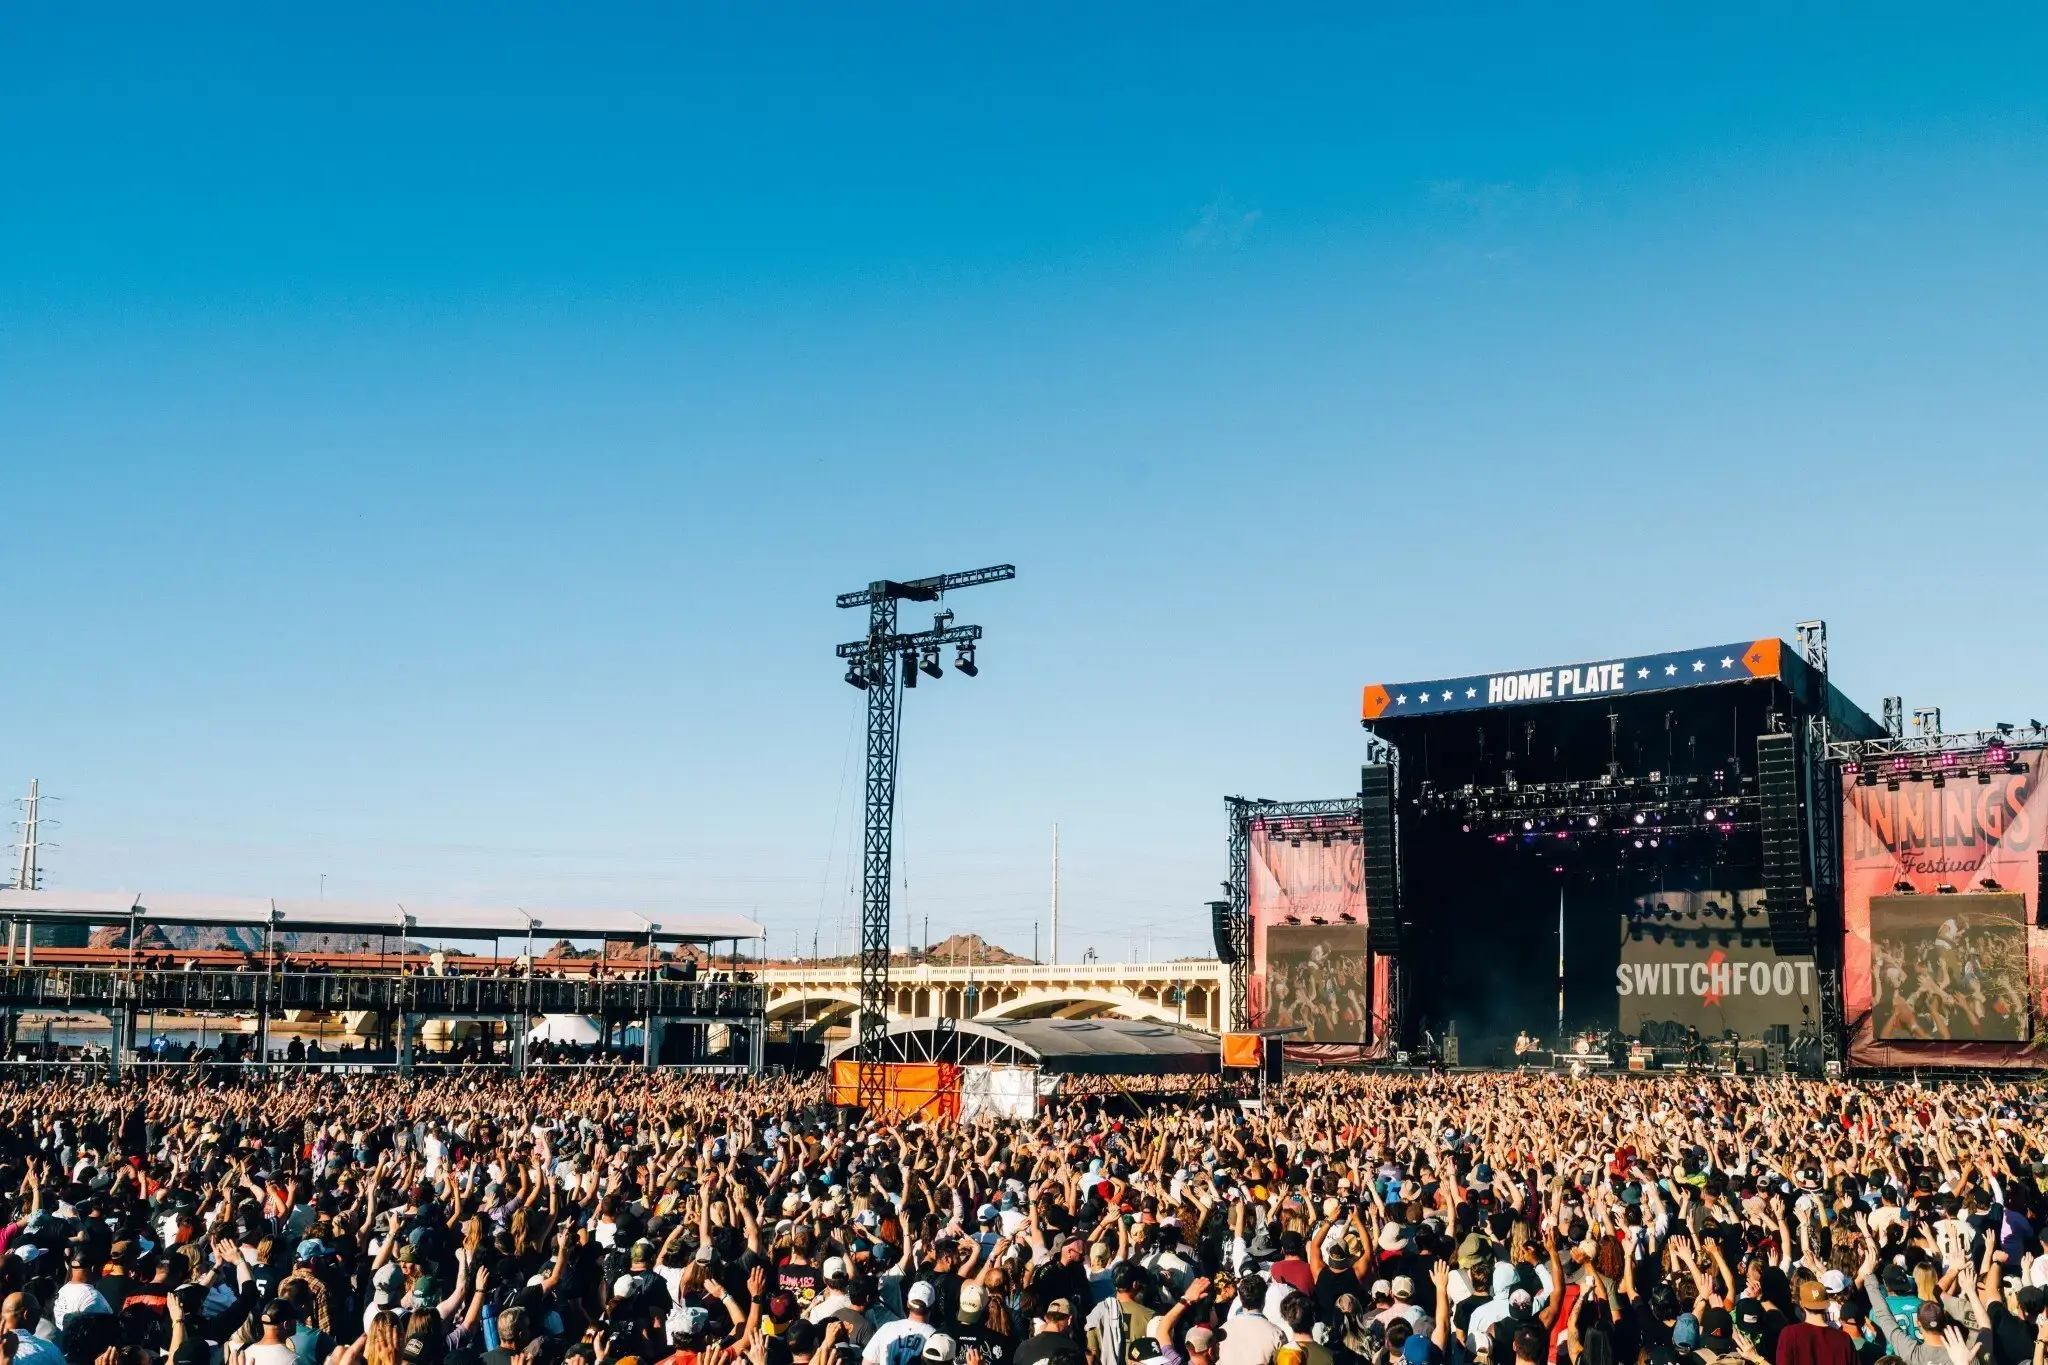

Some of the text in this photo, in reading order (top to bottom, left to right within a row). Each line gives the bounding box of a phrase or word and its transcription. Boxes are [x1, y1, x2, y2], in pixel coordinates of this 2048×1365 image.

[1488, 662, 1625, 704] HOME PLATE
[1852, 774, 2034, 860] INNINGS
[1897, 850, 1988, 876] Festival
[1615, 961, 1816, 996] SWITCHFOOT
